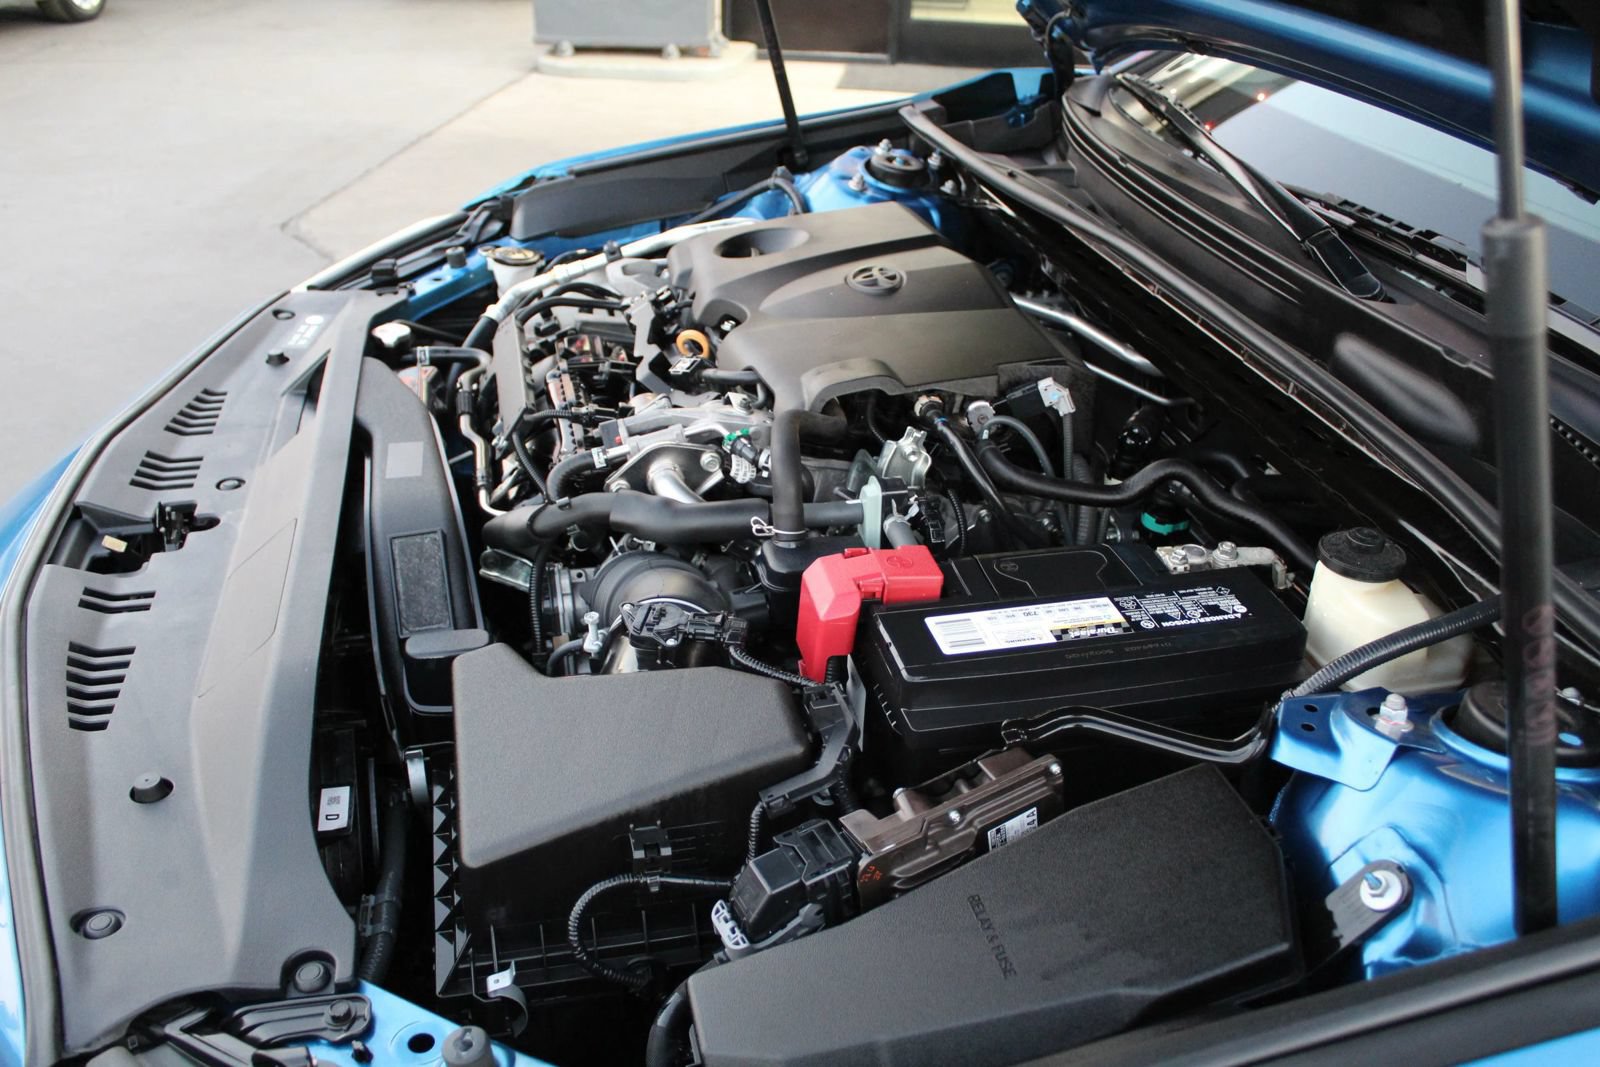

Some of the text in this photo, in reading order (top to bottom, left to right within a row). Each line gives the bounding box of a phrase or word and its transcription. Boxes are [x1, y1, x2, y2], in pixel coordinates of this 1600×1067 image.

[1068, 626, 1118, 638] Duralast
[967, 894, 995, 931] RELAY
[992, 944, 1017, 980] FUSE
